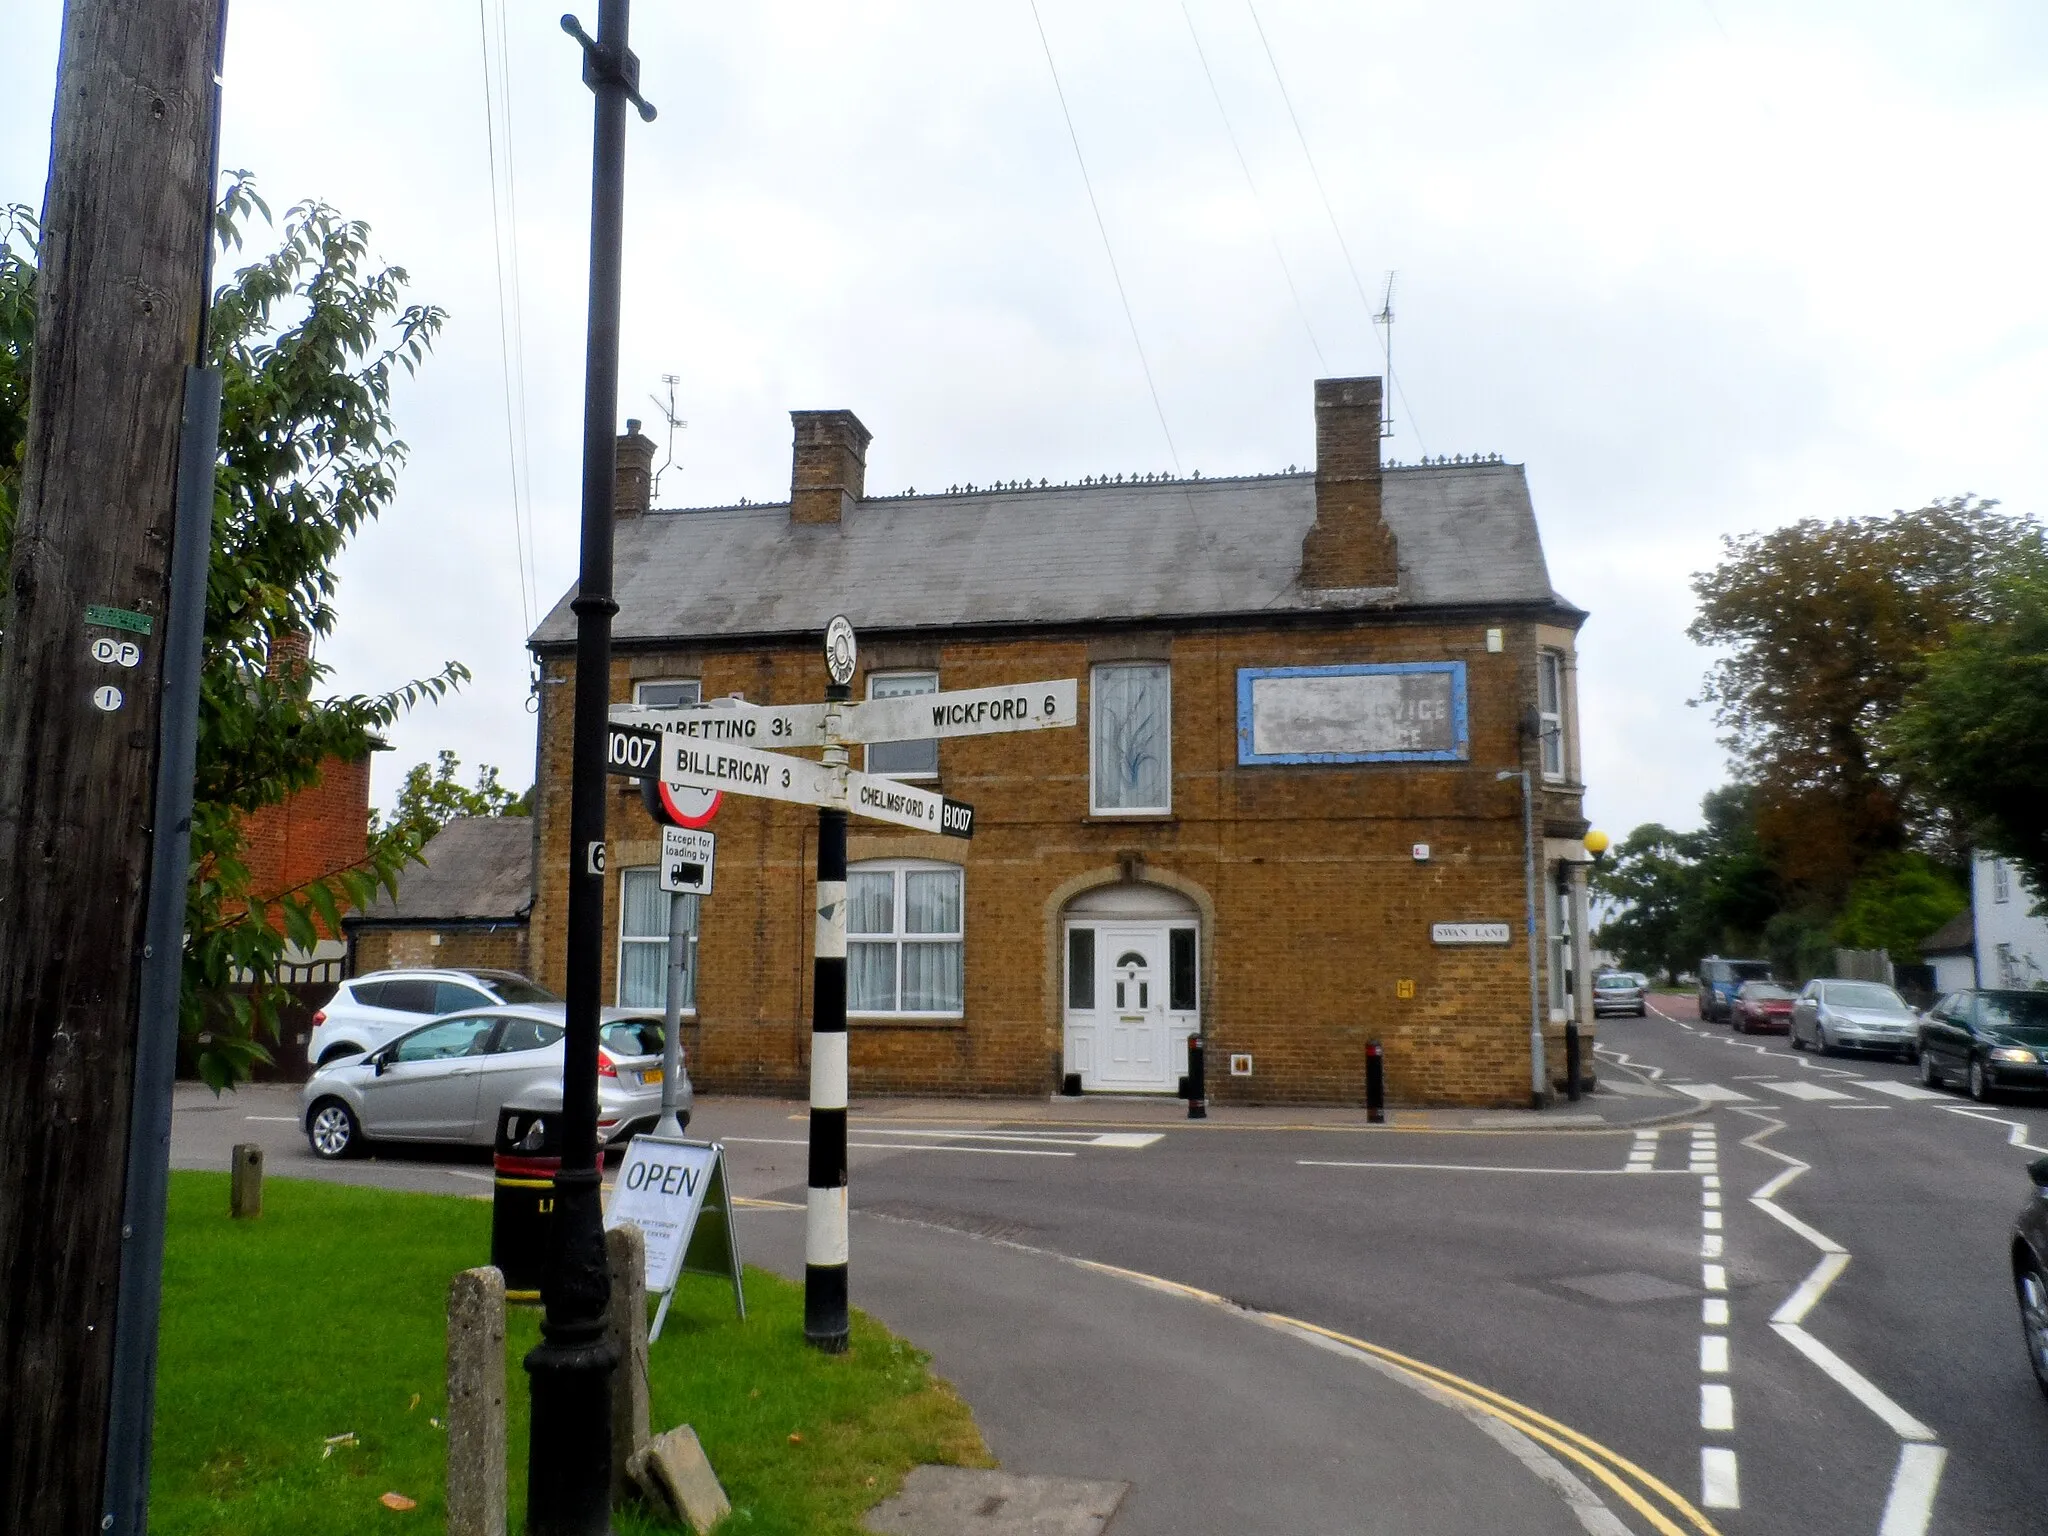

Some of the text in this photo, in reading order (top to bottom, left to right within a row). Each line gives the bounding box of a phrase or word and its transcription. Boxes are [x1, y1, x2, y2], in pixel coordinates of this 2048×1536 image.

[932, 695, 1056, 727] WICKFORD 6
[608, 732, 791, 788] 1007 BILLERICAY 3
[860, 785, 972, 832] CHELMSFORD 6 B1007
[666, 831, 711, 848] Except for
[665, 845, 710, 863] loading by
[1436, 928, 1506, 937] SWAN LANE
[1399, 983, 1411, 995] H
[626, 1160, 701, 1198] OPEN
